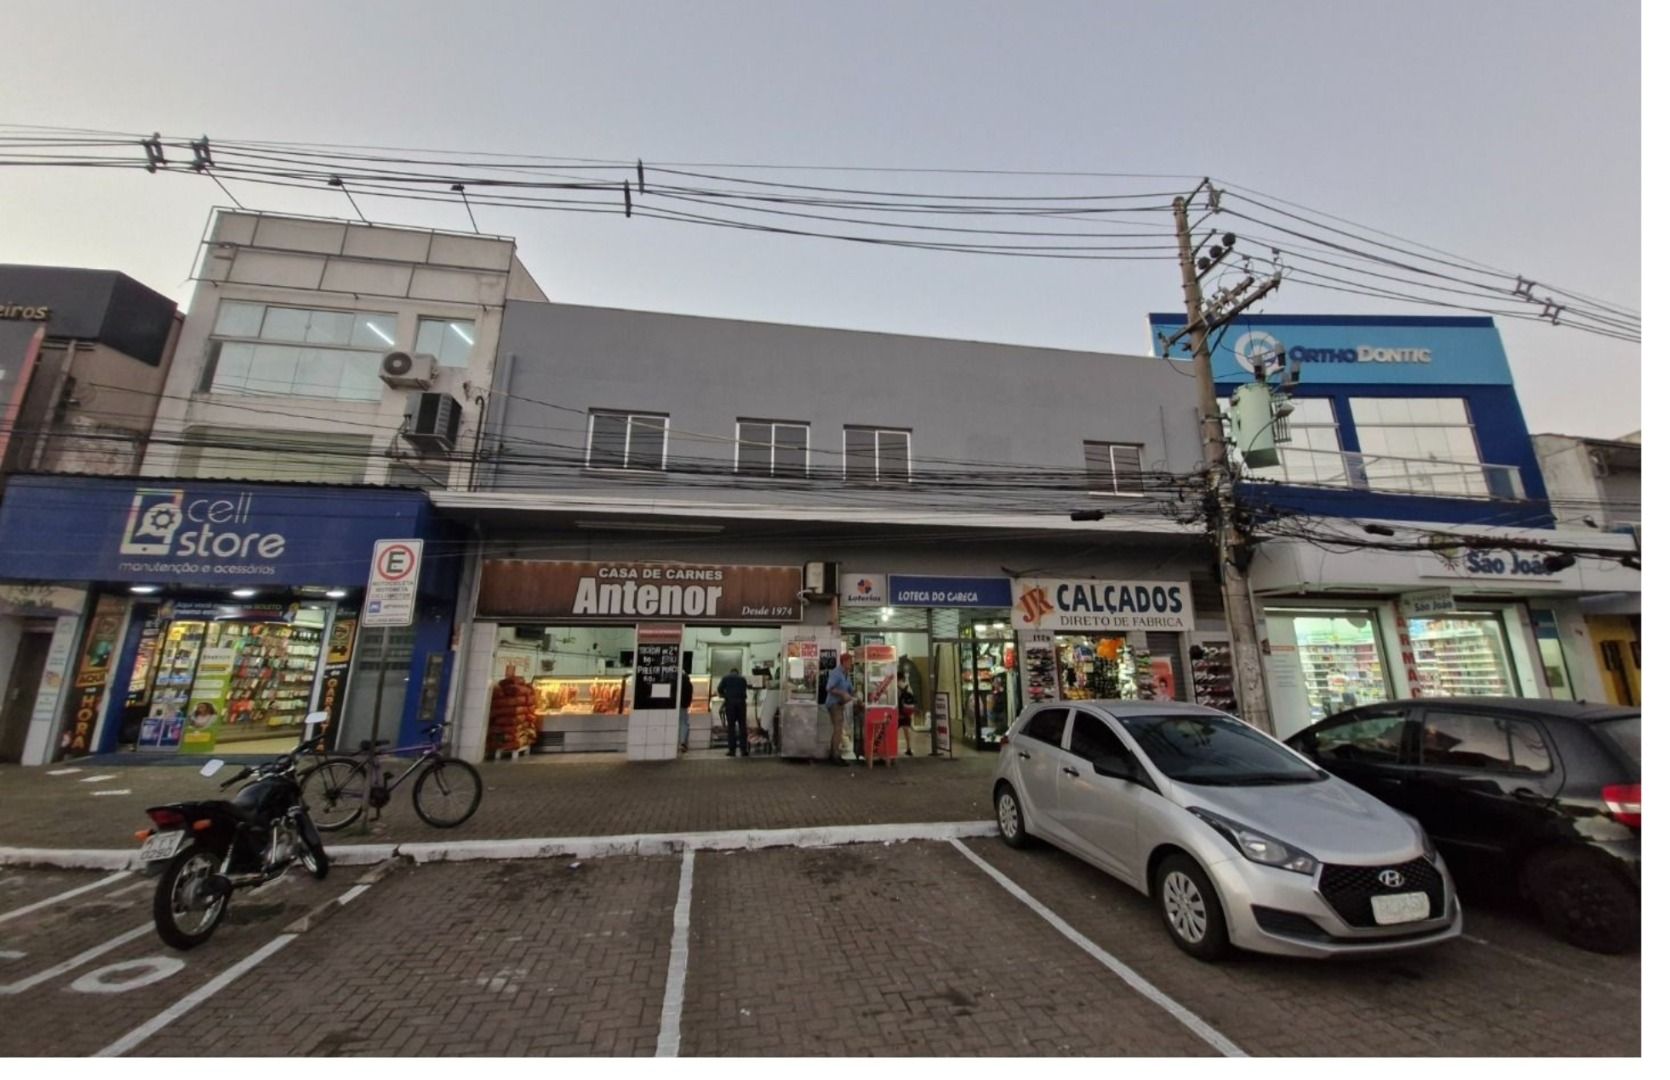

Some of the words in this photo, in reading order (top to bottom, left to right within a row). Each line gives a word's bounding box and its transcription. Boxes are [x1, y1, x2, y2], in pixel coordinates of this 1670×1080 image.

[188, 492, 252, 524] cell
[176, 523, 286, 558] store
[119, 562, 198, 574] manutenção
[386, 551, 406, 573] E
[1467, 548, 1505, 574] São
[598, 567, 638, 579] CASA
[642, 568, 661, 579] DE
[665, 569, 723, 580] CARNES
[572, 577, 723, 616] Antenor
[848, 594, 881, 602] Loterias
[898, 591, 929, 602] LOTECA
[932, 591, 945, 602] DO
[1057, 584, 1183, 614] CALÇADOS
[741, 606, 769, 616] Desde
[771, 606, 793, 617] 1974
[1060, 615, 1110, 627] DIRETO
[1113, 616, 1129, 627] DE
[1132, 617, 1184, 628] FABRICA
[71, 695, 95, 749] HORA
